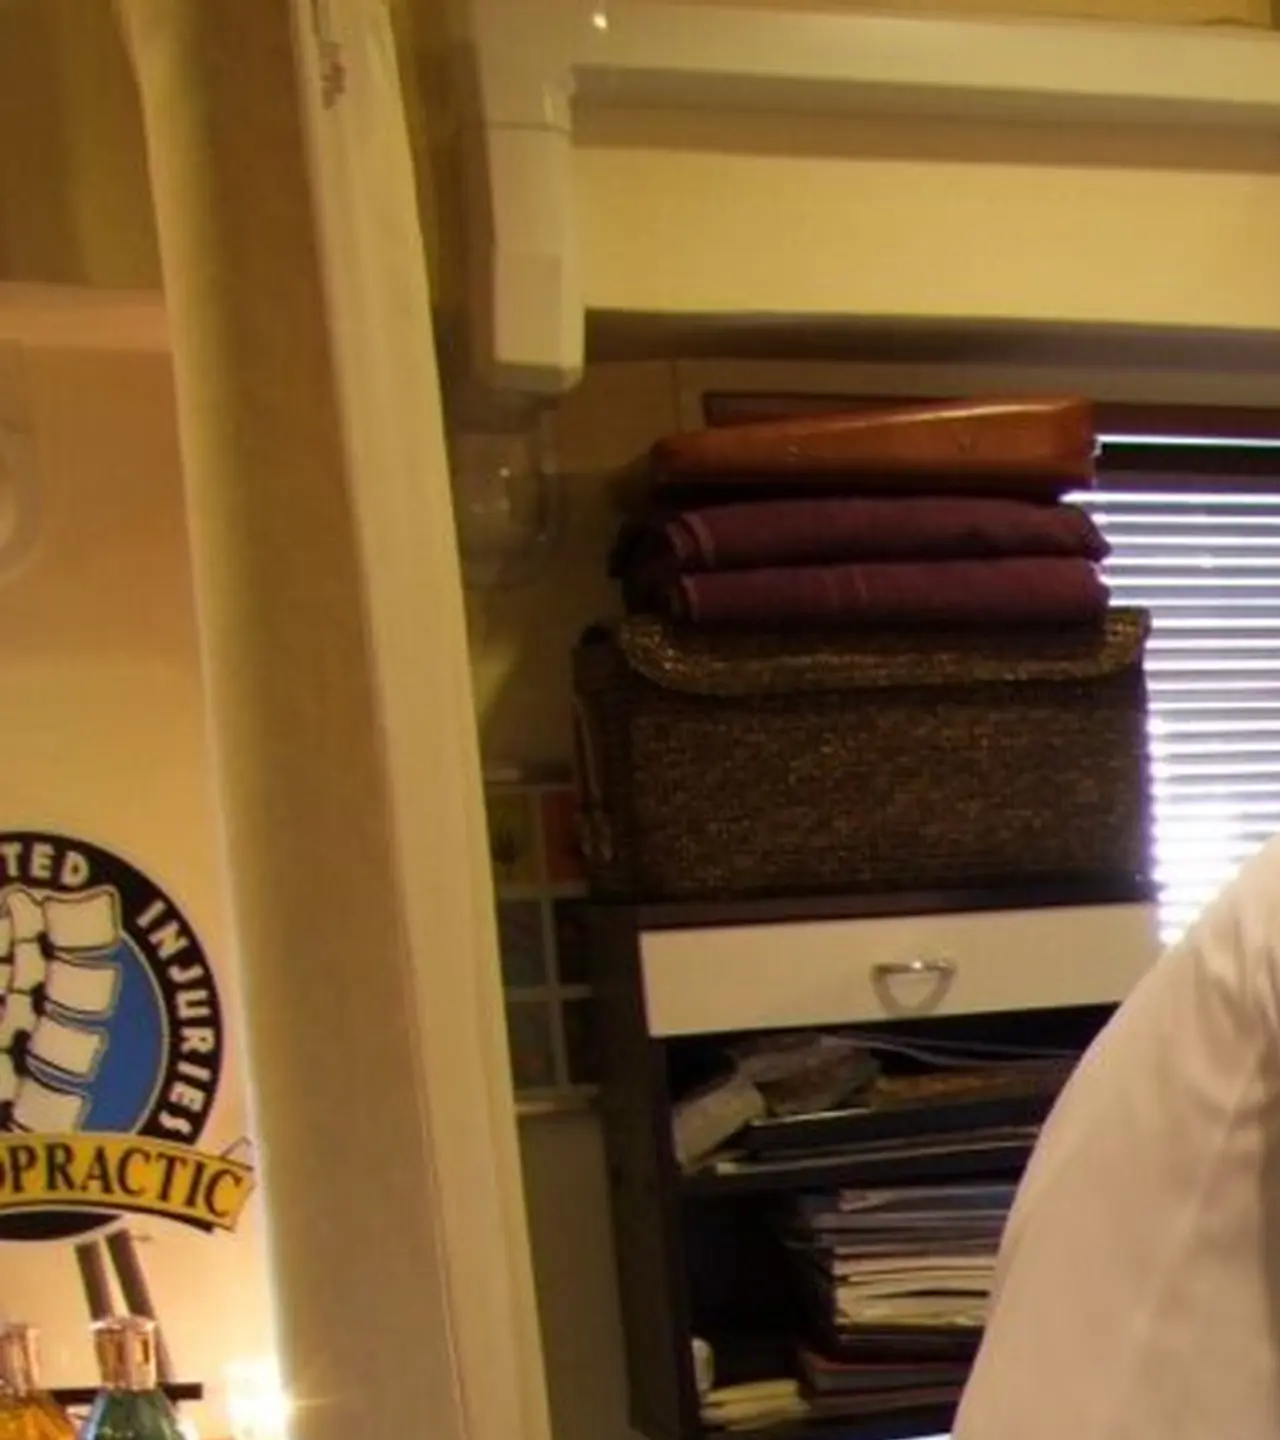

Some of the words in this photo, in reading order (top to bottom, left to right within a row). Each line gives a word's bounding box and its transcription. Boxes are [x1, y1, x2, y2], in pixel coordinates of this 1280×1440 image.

[0, 841, 90, 888] TED
[136, 899, 217, 1135] INJURIES
[0, 1141, 242, 1217] PRACTIC
